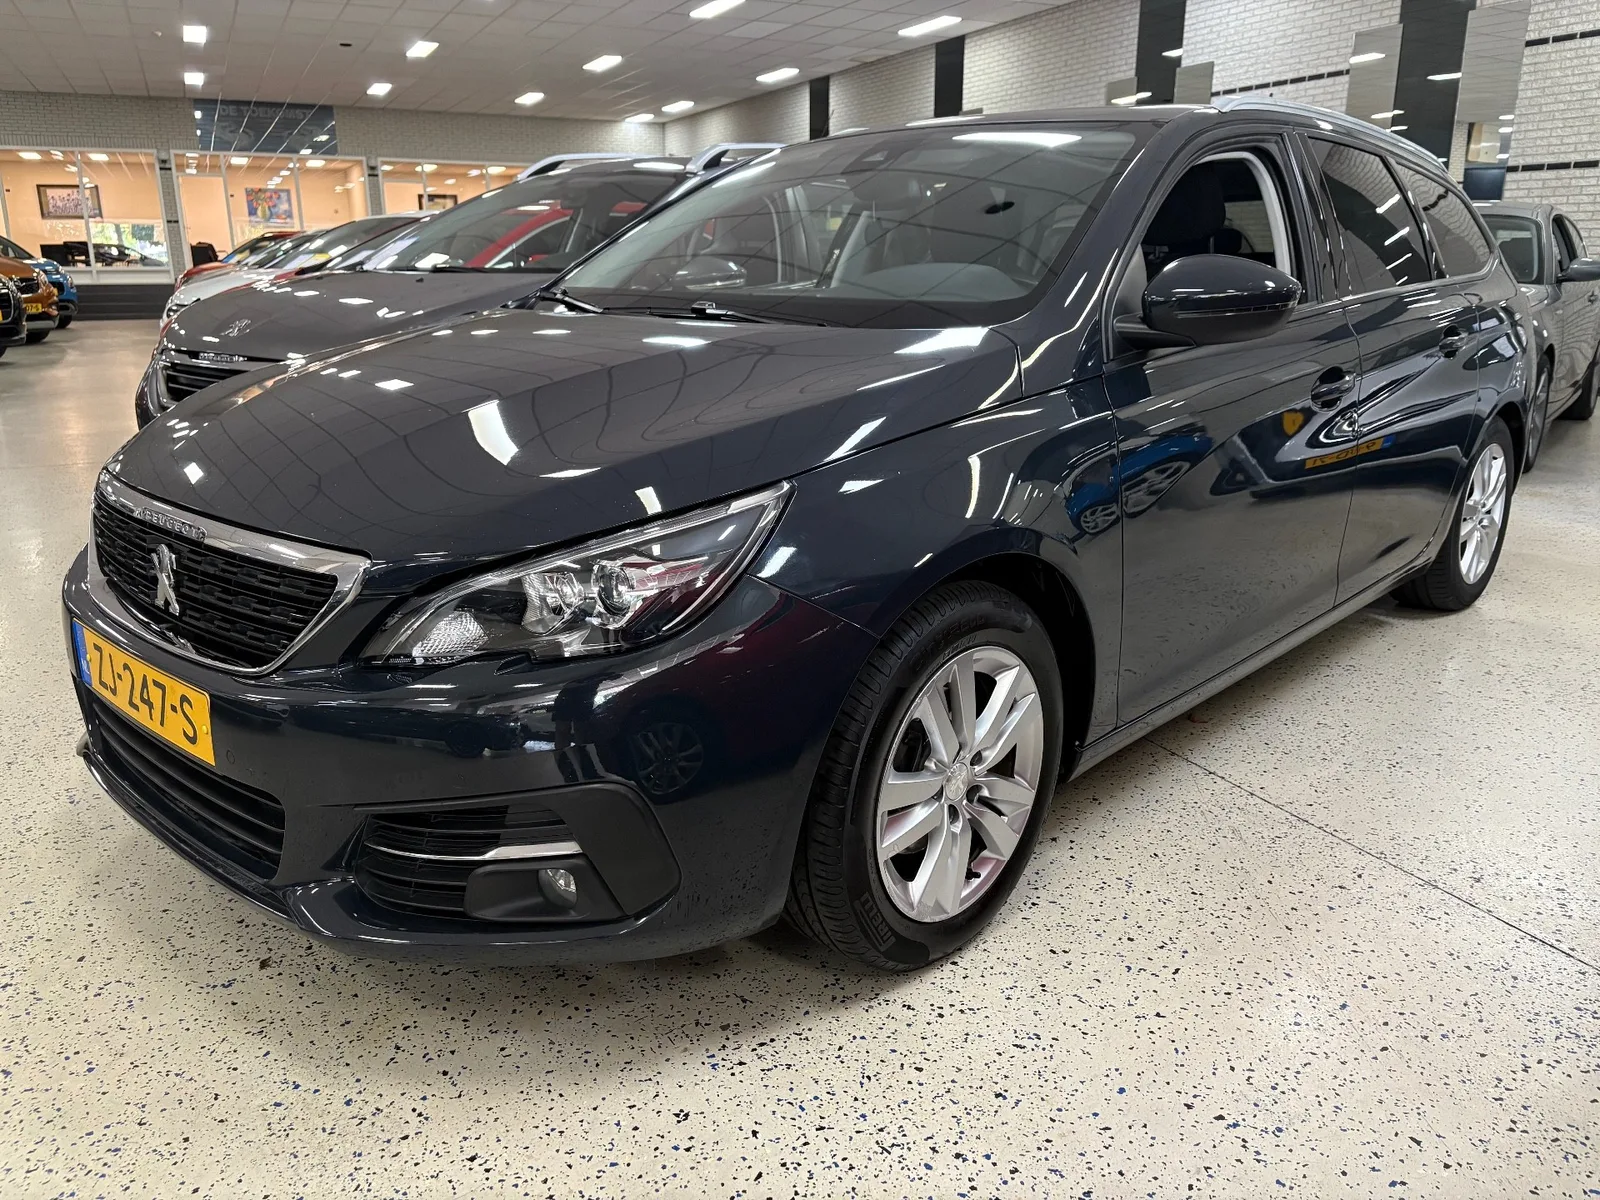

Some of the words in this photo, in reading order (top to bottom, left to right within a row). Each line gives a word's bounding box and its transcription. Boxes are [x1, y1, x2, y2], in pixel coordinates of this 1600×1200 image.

[220, 105, 238, 117] DE
[145, 508, 199, 538] PEUGEOT
[93, 642, 198, 746] ZJ-247-S
